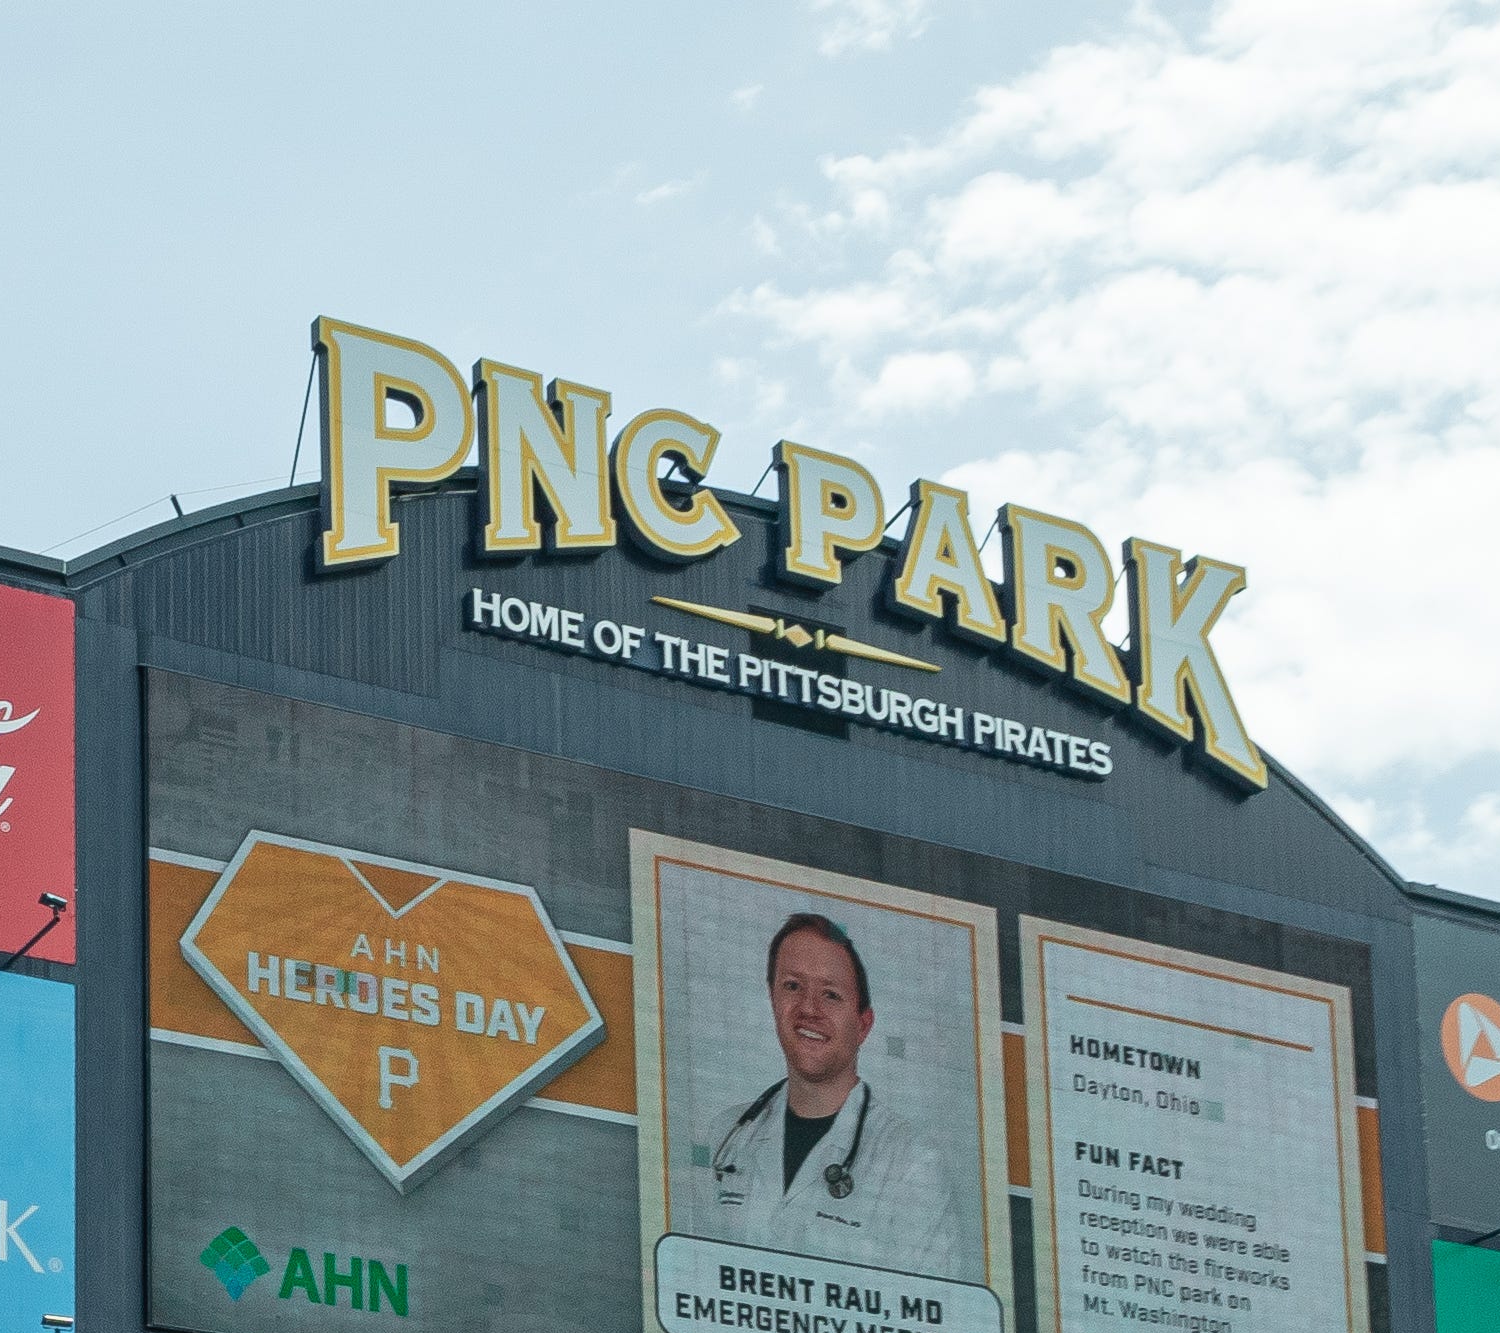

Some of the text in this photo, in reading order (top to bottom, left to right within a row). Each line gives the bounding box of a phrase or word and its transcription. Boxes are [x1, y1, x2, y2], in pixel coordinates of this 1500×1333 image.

[312, 314, 1268, 795] PNC PARK
[472, 588, 1112, 778] HOME OF THE PITTSBURGH PIRATES
[349, 934, 440, 973] AHN
[246, 950, 546, 1045] HEROES DAY
[376, 1046, 419, 1110] P
[1069, 1034, 1201, 1080] HOMETOWN
[1073, 1073, 1201, 1116] Dayton, Ohio
[1074, 1141, 1183, 1181] FUN FACT
[1077, 1179, 1257, 1233] During my wedding
[1079, 1211, 1290, 1263] reception we were able
[277, 1246, 411, 1318] AHN
[1081, 1239, 1290, 1291] to watch the fireworks
[1081, 1263, 1252, 1312] from PNC park on
[718, 1264, 943, 1326] BRENT RAU, MD
